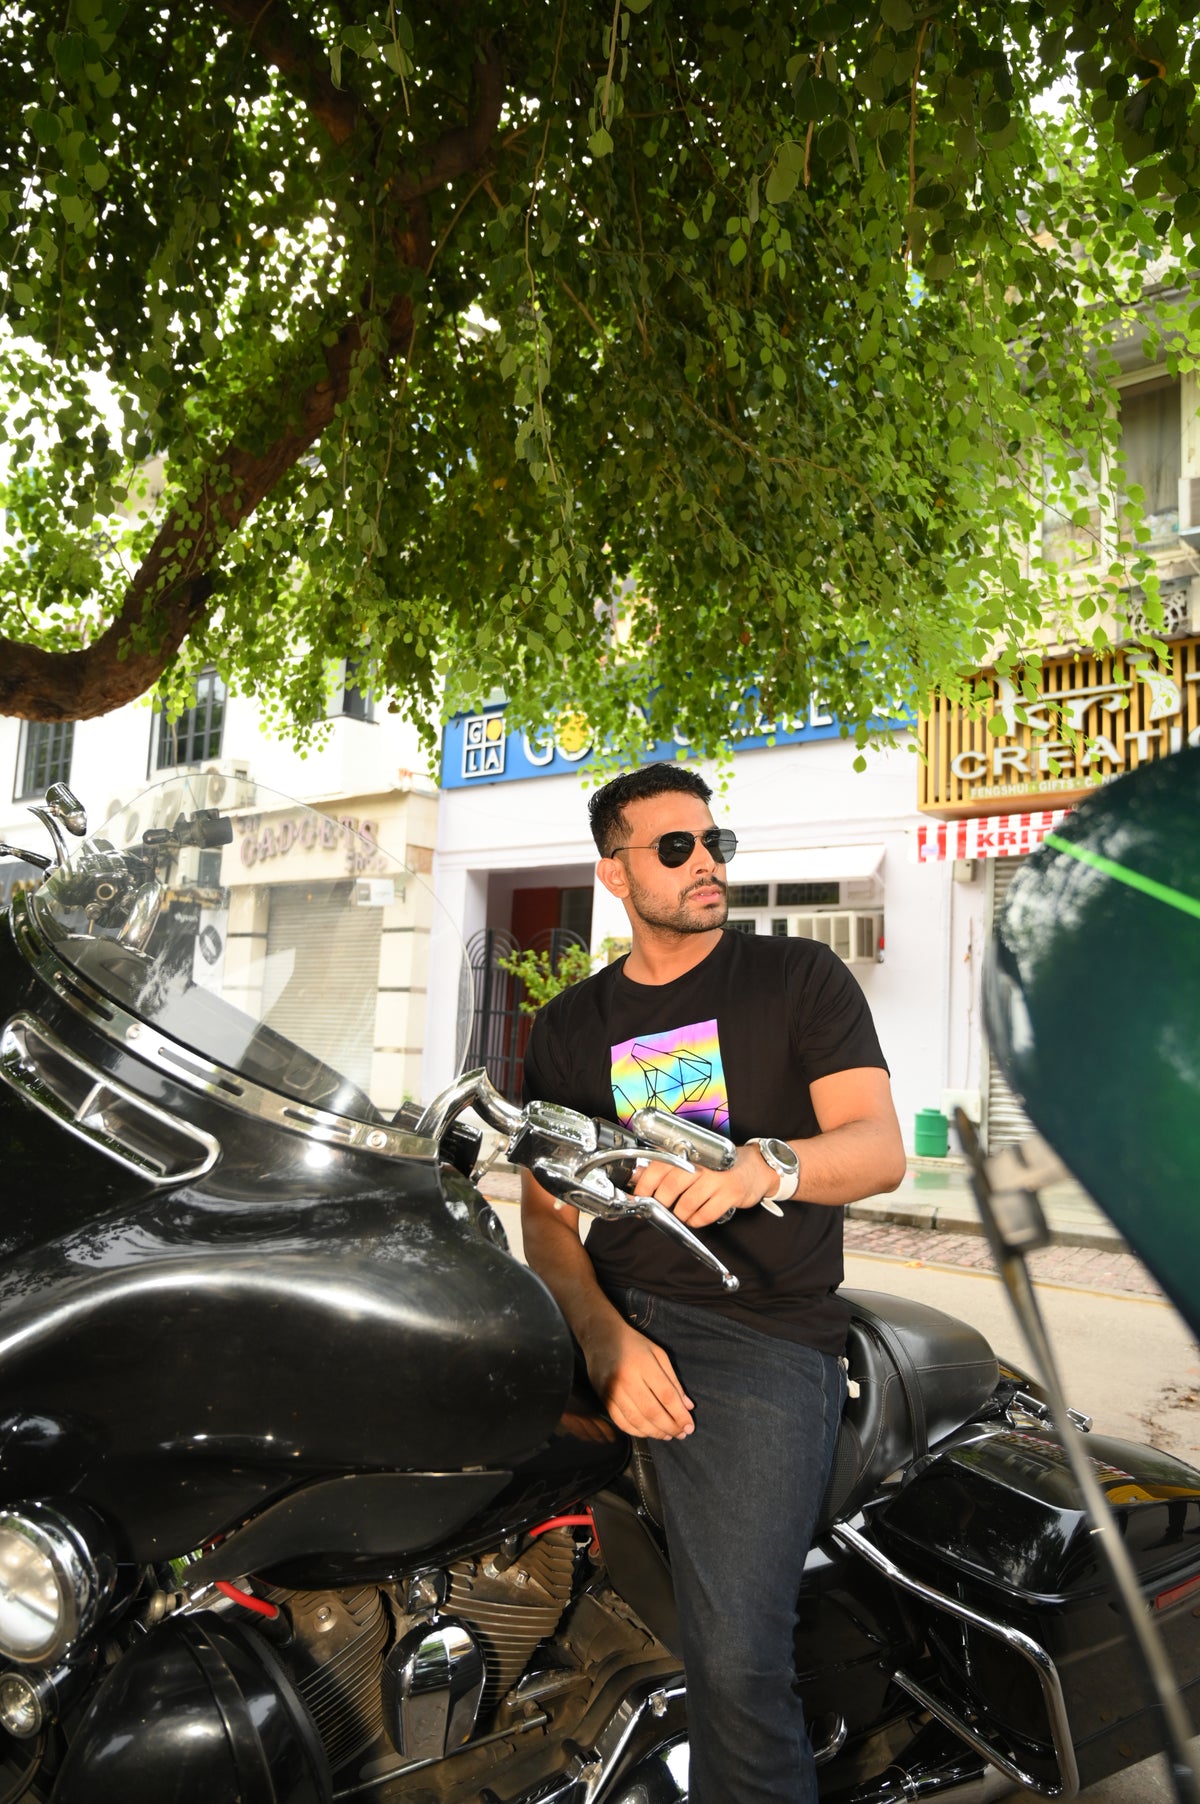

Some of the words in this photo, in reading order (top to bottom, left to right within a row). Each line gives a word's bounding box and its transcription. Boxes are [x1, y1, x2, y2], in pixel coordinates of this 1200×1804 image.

[951, 725, 1200, 780] CREATI
[971, 783, 1029, 798] FENGSHUI
[1039, 778, 1074, 792] GIFTS
[977, 826, 1058, 847] KRIT
